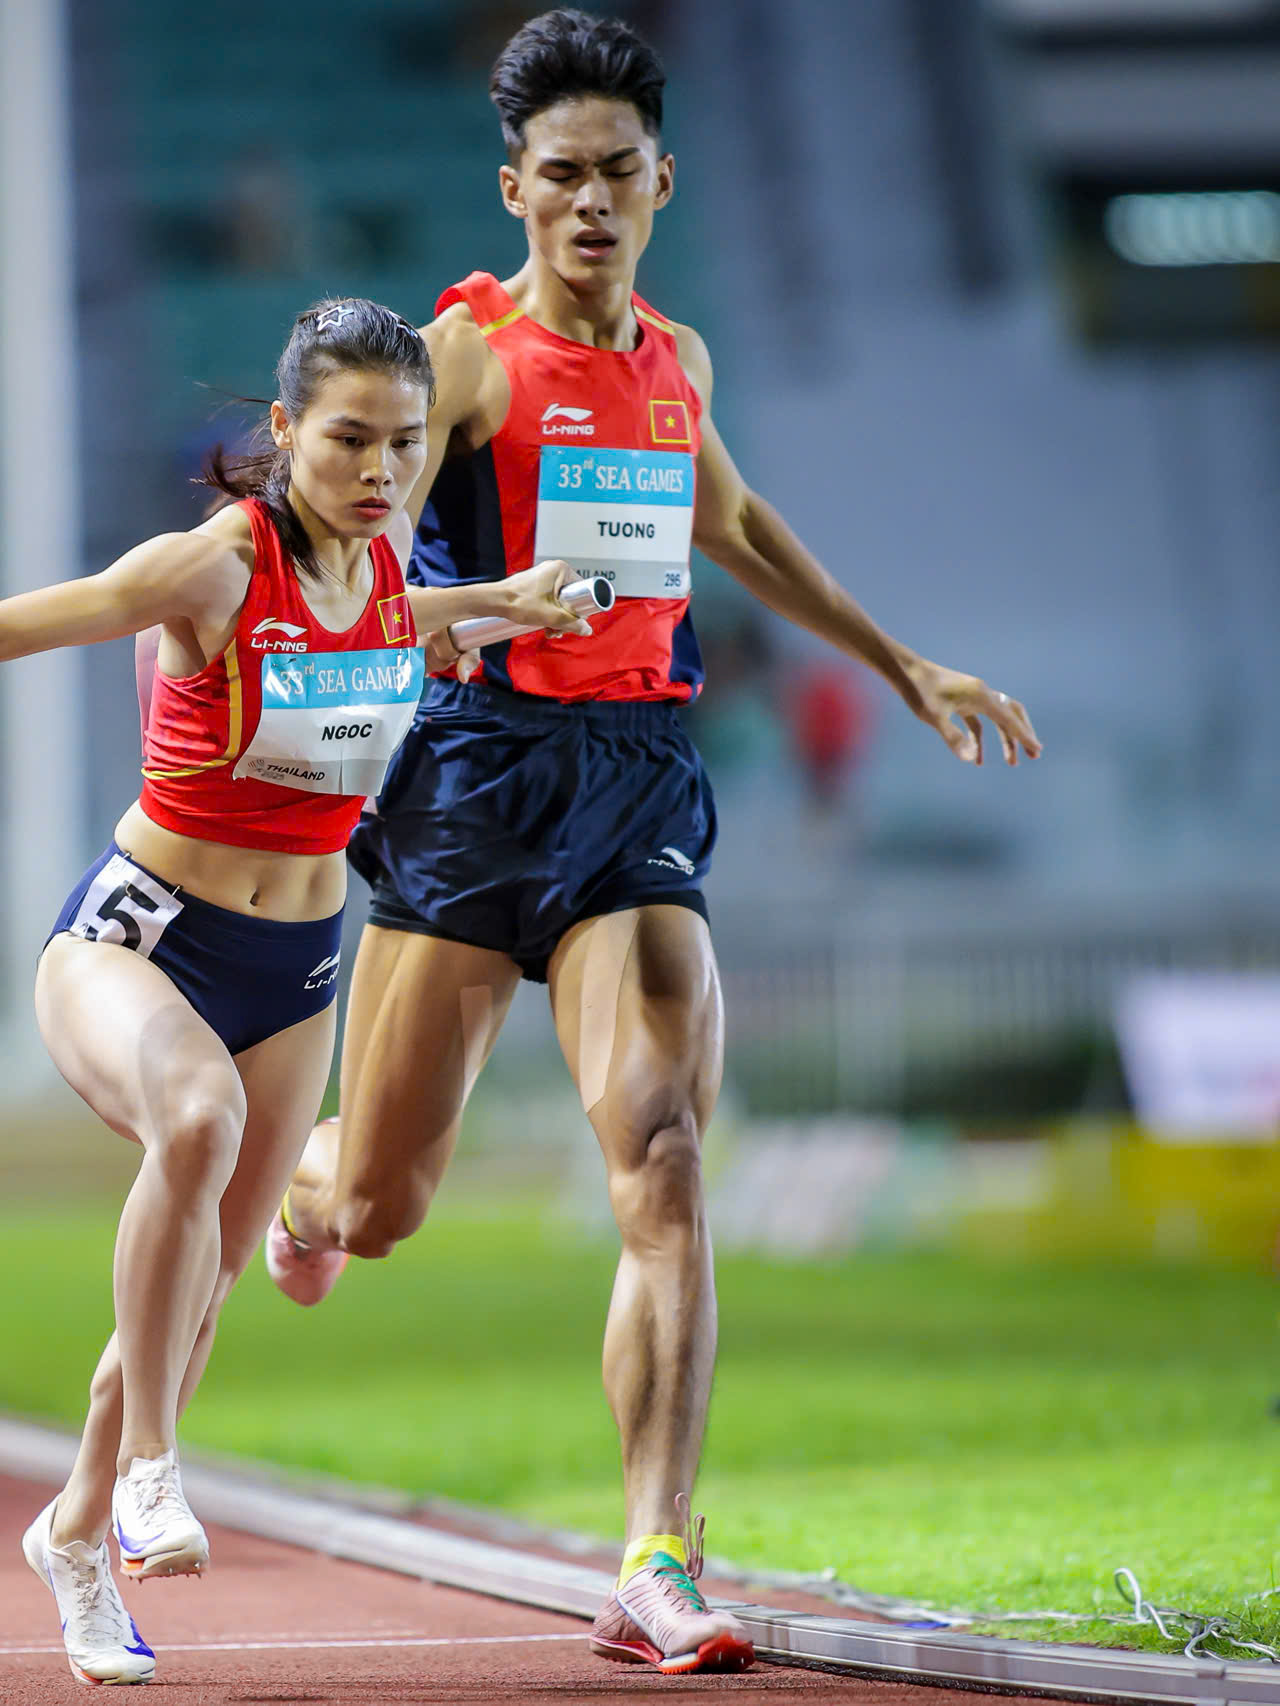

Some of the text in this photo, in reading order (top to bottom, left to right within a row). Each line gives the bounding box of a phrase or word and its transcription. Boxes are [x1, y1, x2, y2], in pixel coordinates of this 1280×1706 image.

[542, 424, 595, 436] LI-NING
[595, 465, 631, 490] SEA
[636, 467, 683, 493] GAMES
[597, 521, 655, 539] TUONG
[317, 668, 348, 694] SEA
[321, 723, 373, 741] NGOC
[266, 764, 326, 781] THAILAND
[83, 880, 160, 952] 5
